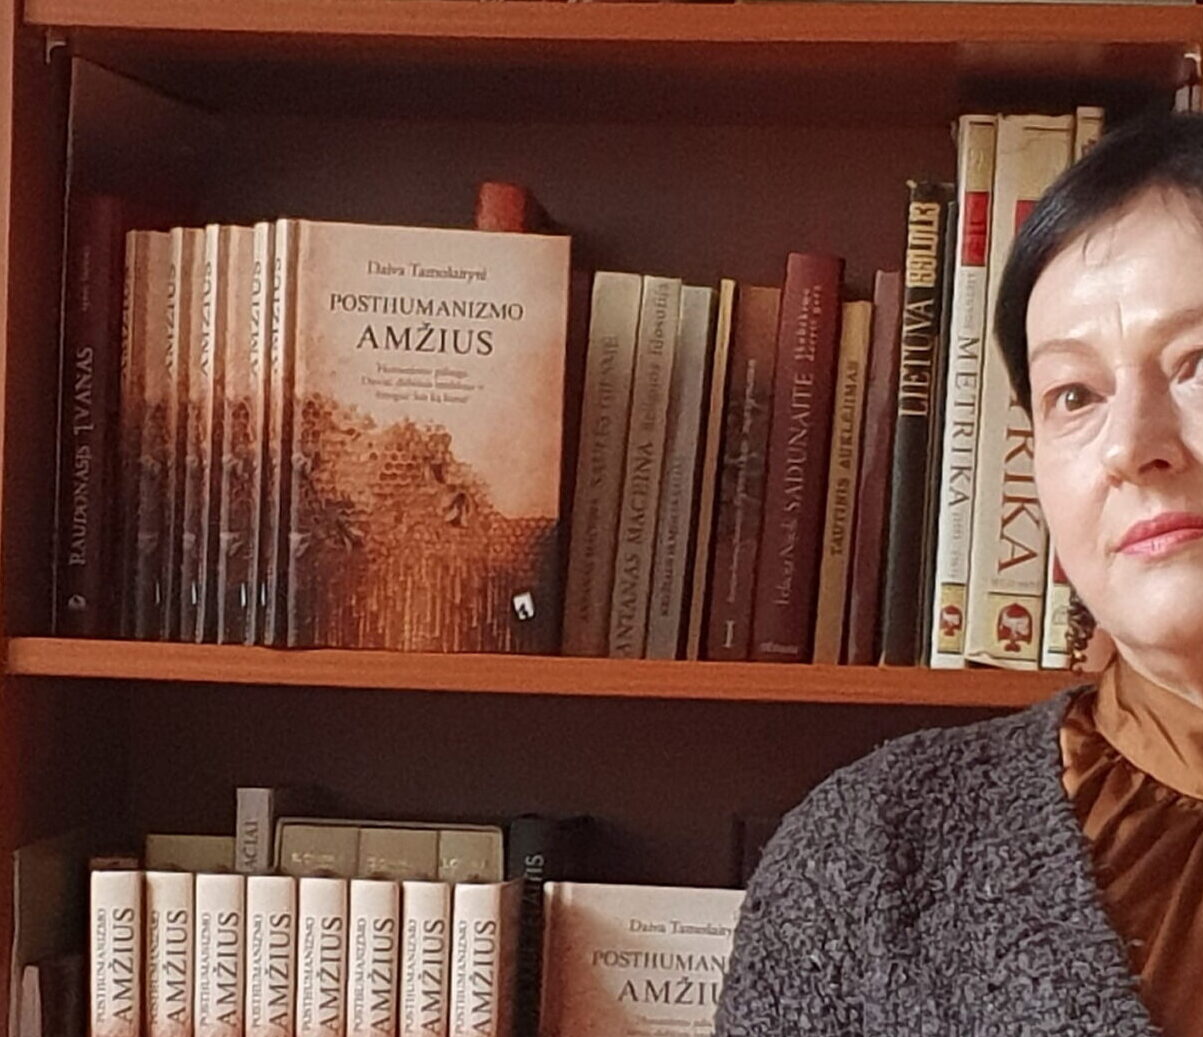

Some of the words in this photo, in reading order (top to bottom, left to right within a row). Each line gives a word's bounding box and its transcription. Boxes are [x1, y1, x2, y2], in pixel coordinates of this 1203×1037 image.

[329, 293, 523, 320] POSTHUMANIZMO
[356, 320, 492, 356] AMŽIUS
[898, 299, 934, 417] LIETUVA
[72, 346, 95, 436] TVANAS
[948, 335, 981, 508] METRIKA
[626, 442, 654, 545] MACEINA
[616, 553, 640, 653] ANTANAS
[107, 908, 135, 1024] AMŽIUS
[161, 910, 188, 1026] AMŽIUS
[212, 911, 240, 1028] AMŽIUS
[263, 913, 292, 1030] AMŽIUS
[315, 916, 343, 1034] AMŽIUS
[366, 918, 395, 1034] AMŽIUS
[418, 919, 445, 1036] AMŽIUS
[469, 920, 497, 1037] AMŽIUS
[592, 950, 726, 973] POSTHUMAN
